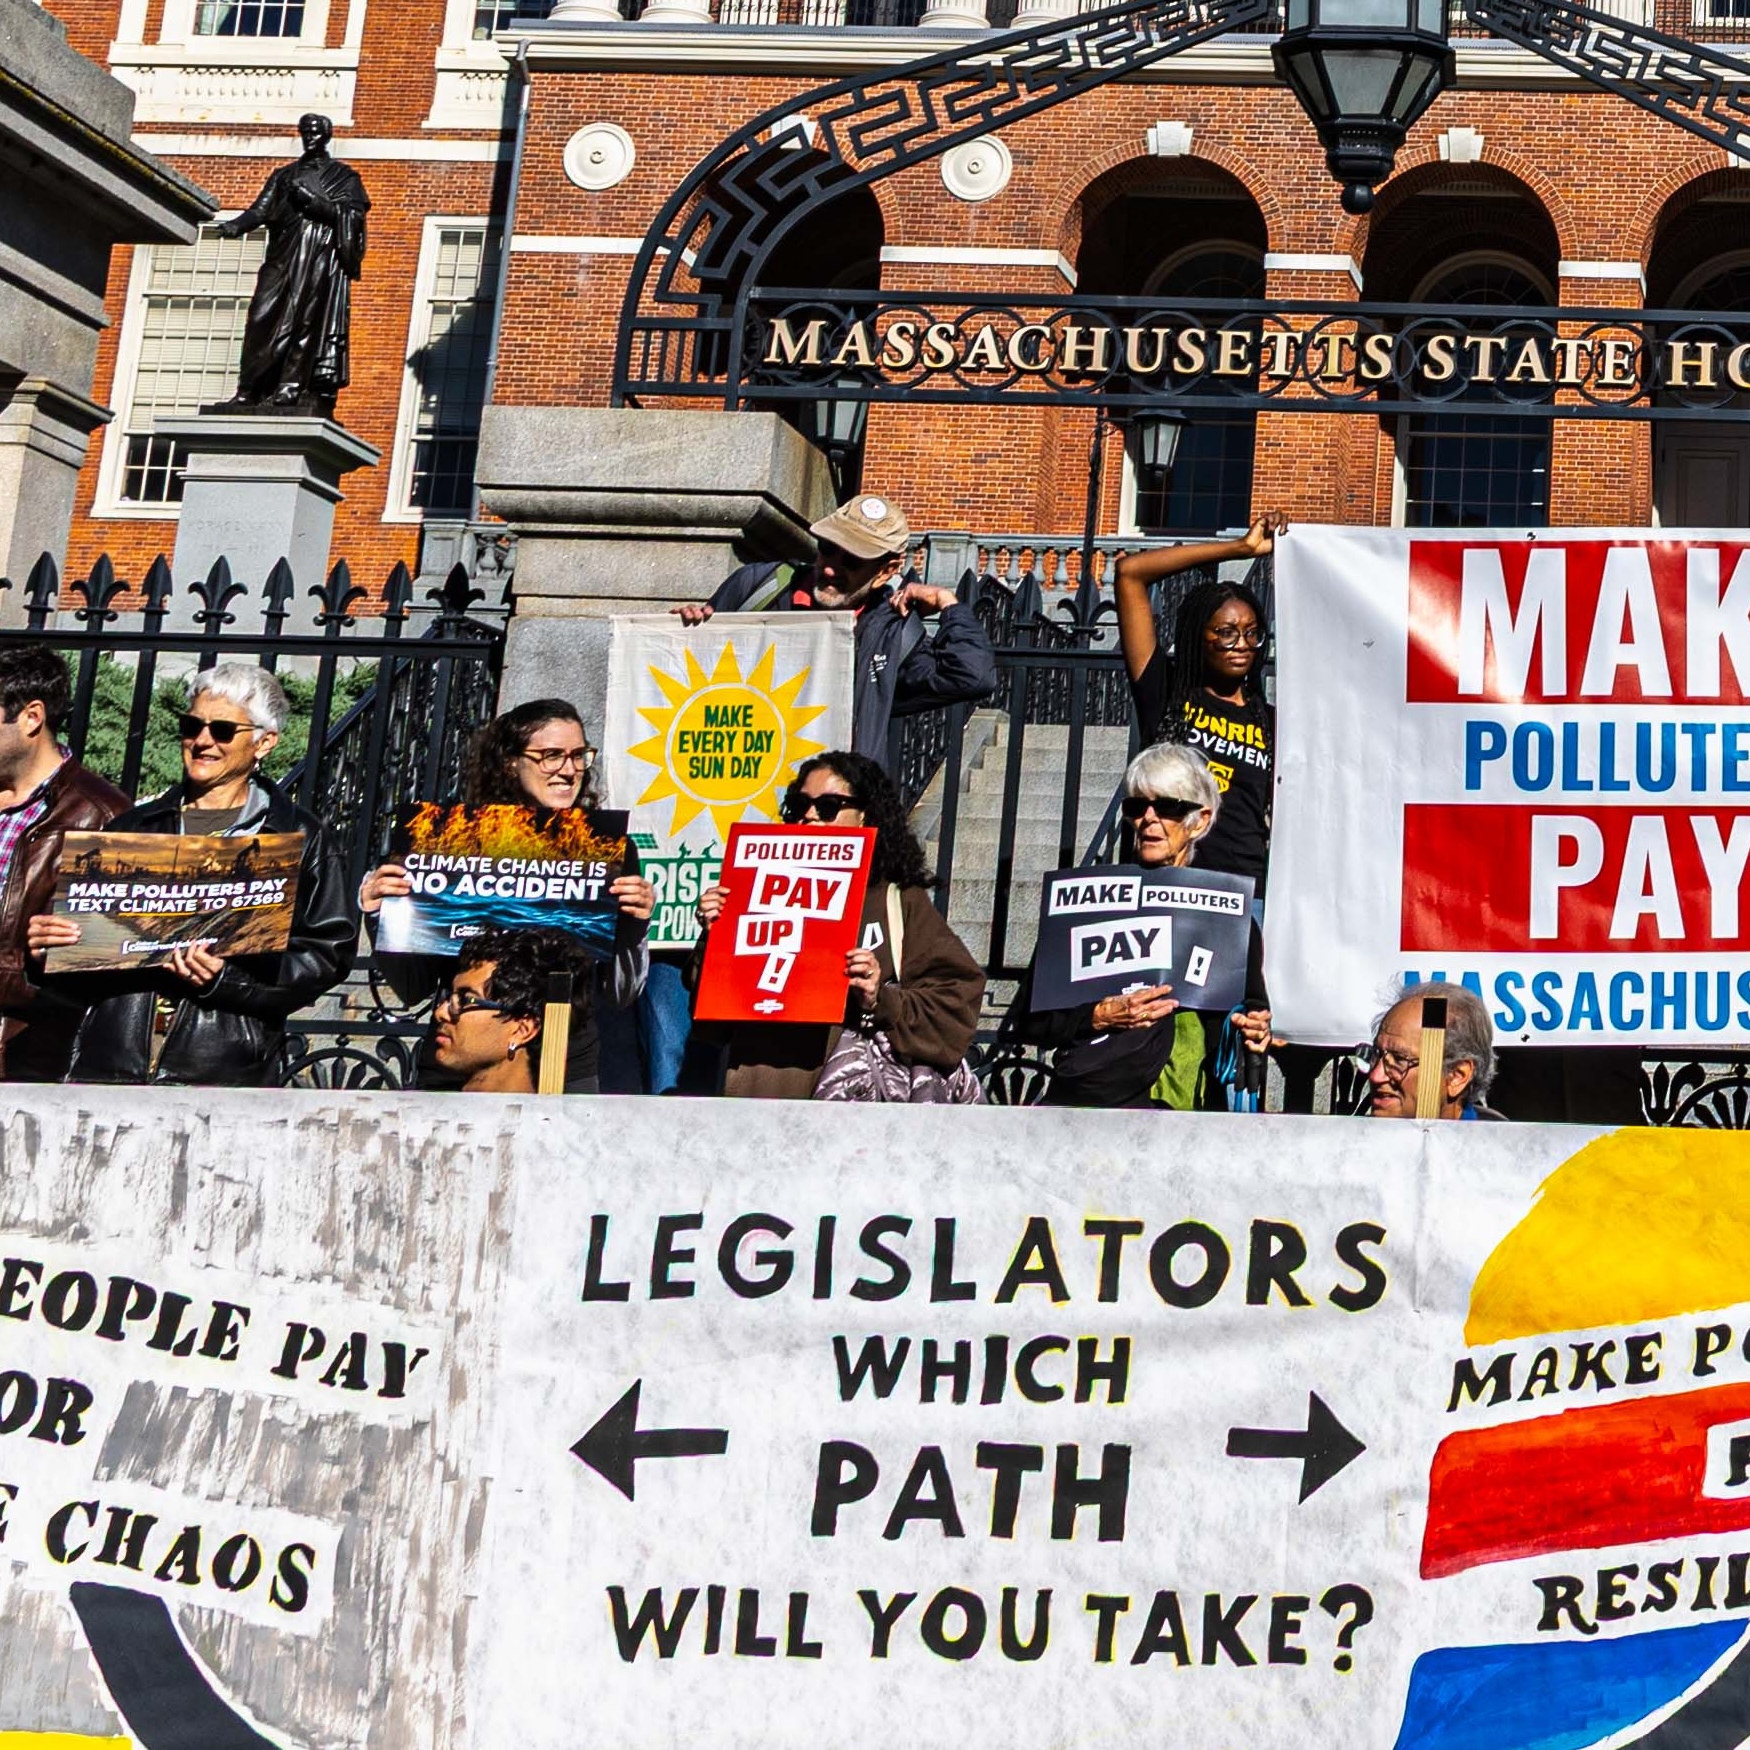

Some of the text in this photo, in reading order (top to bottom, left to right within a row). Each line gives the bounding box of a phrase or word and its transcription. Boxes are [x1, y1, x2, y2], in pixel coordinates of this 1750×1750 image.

[763, 318, 1394, 381] MASSACHUSETTS
[1423, 335, 1637, 385] STATE
[704, 705, 754, 728] MAKE
[678, 730, 775, 753] EVERY DAY
[689, 756, 763, 779] SUN DAY
[404, 853, 607, 877] CLIMATE CHANGE IS
[744, 842, 855, 861] POLLUTERS
[66, 891, 284, 912] TEXT CLIMATE TO 67369
[68, 878, 288, 898] MAKE POLLUTERS PAY
[406, 872, 606, 900] NO ACCIDENT
[760, 874, 842, 911] PAY
[1055, 884, 1240, 910] MAKE POLLUTERS
[746, 920, 794, 947] UP
[1081, 927, 1204, 976] PAY !
[768, 958, 788, 985] !
[582, 1212, 1387, 1314] LEGISLATORS
[0, 1258, 430, 1398] EOPLE PAY
[833, 1335, 1132, 1405] WHICH
[1446, 1332, 1665, 1413] MAKE
[0, 1370, 94, 1446] OR
[810, 1441, 1132, 1542] PATH
[45, 1500, 317, 1612] CHAOS
[606, 1583, 1375, 1674] WILL YOU TAKE?
